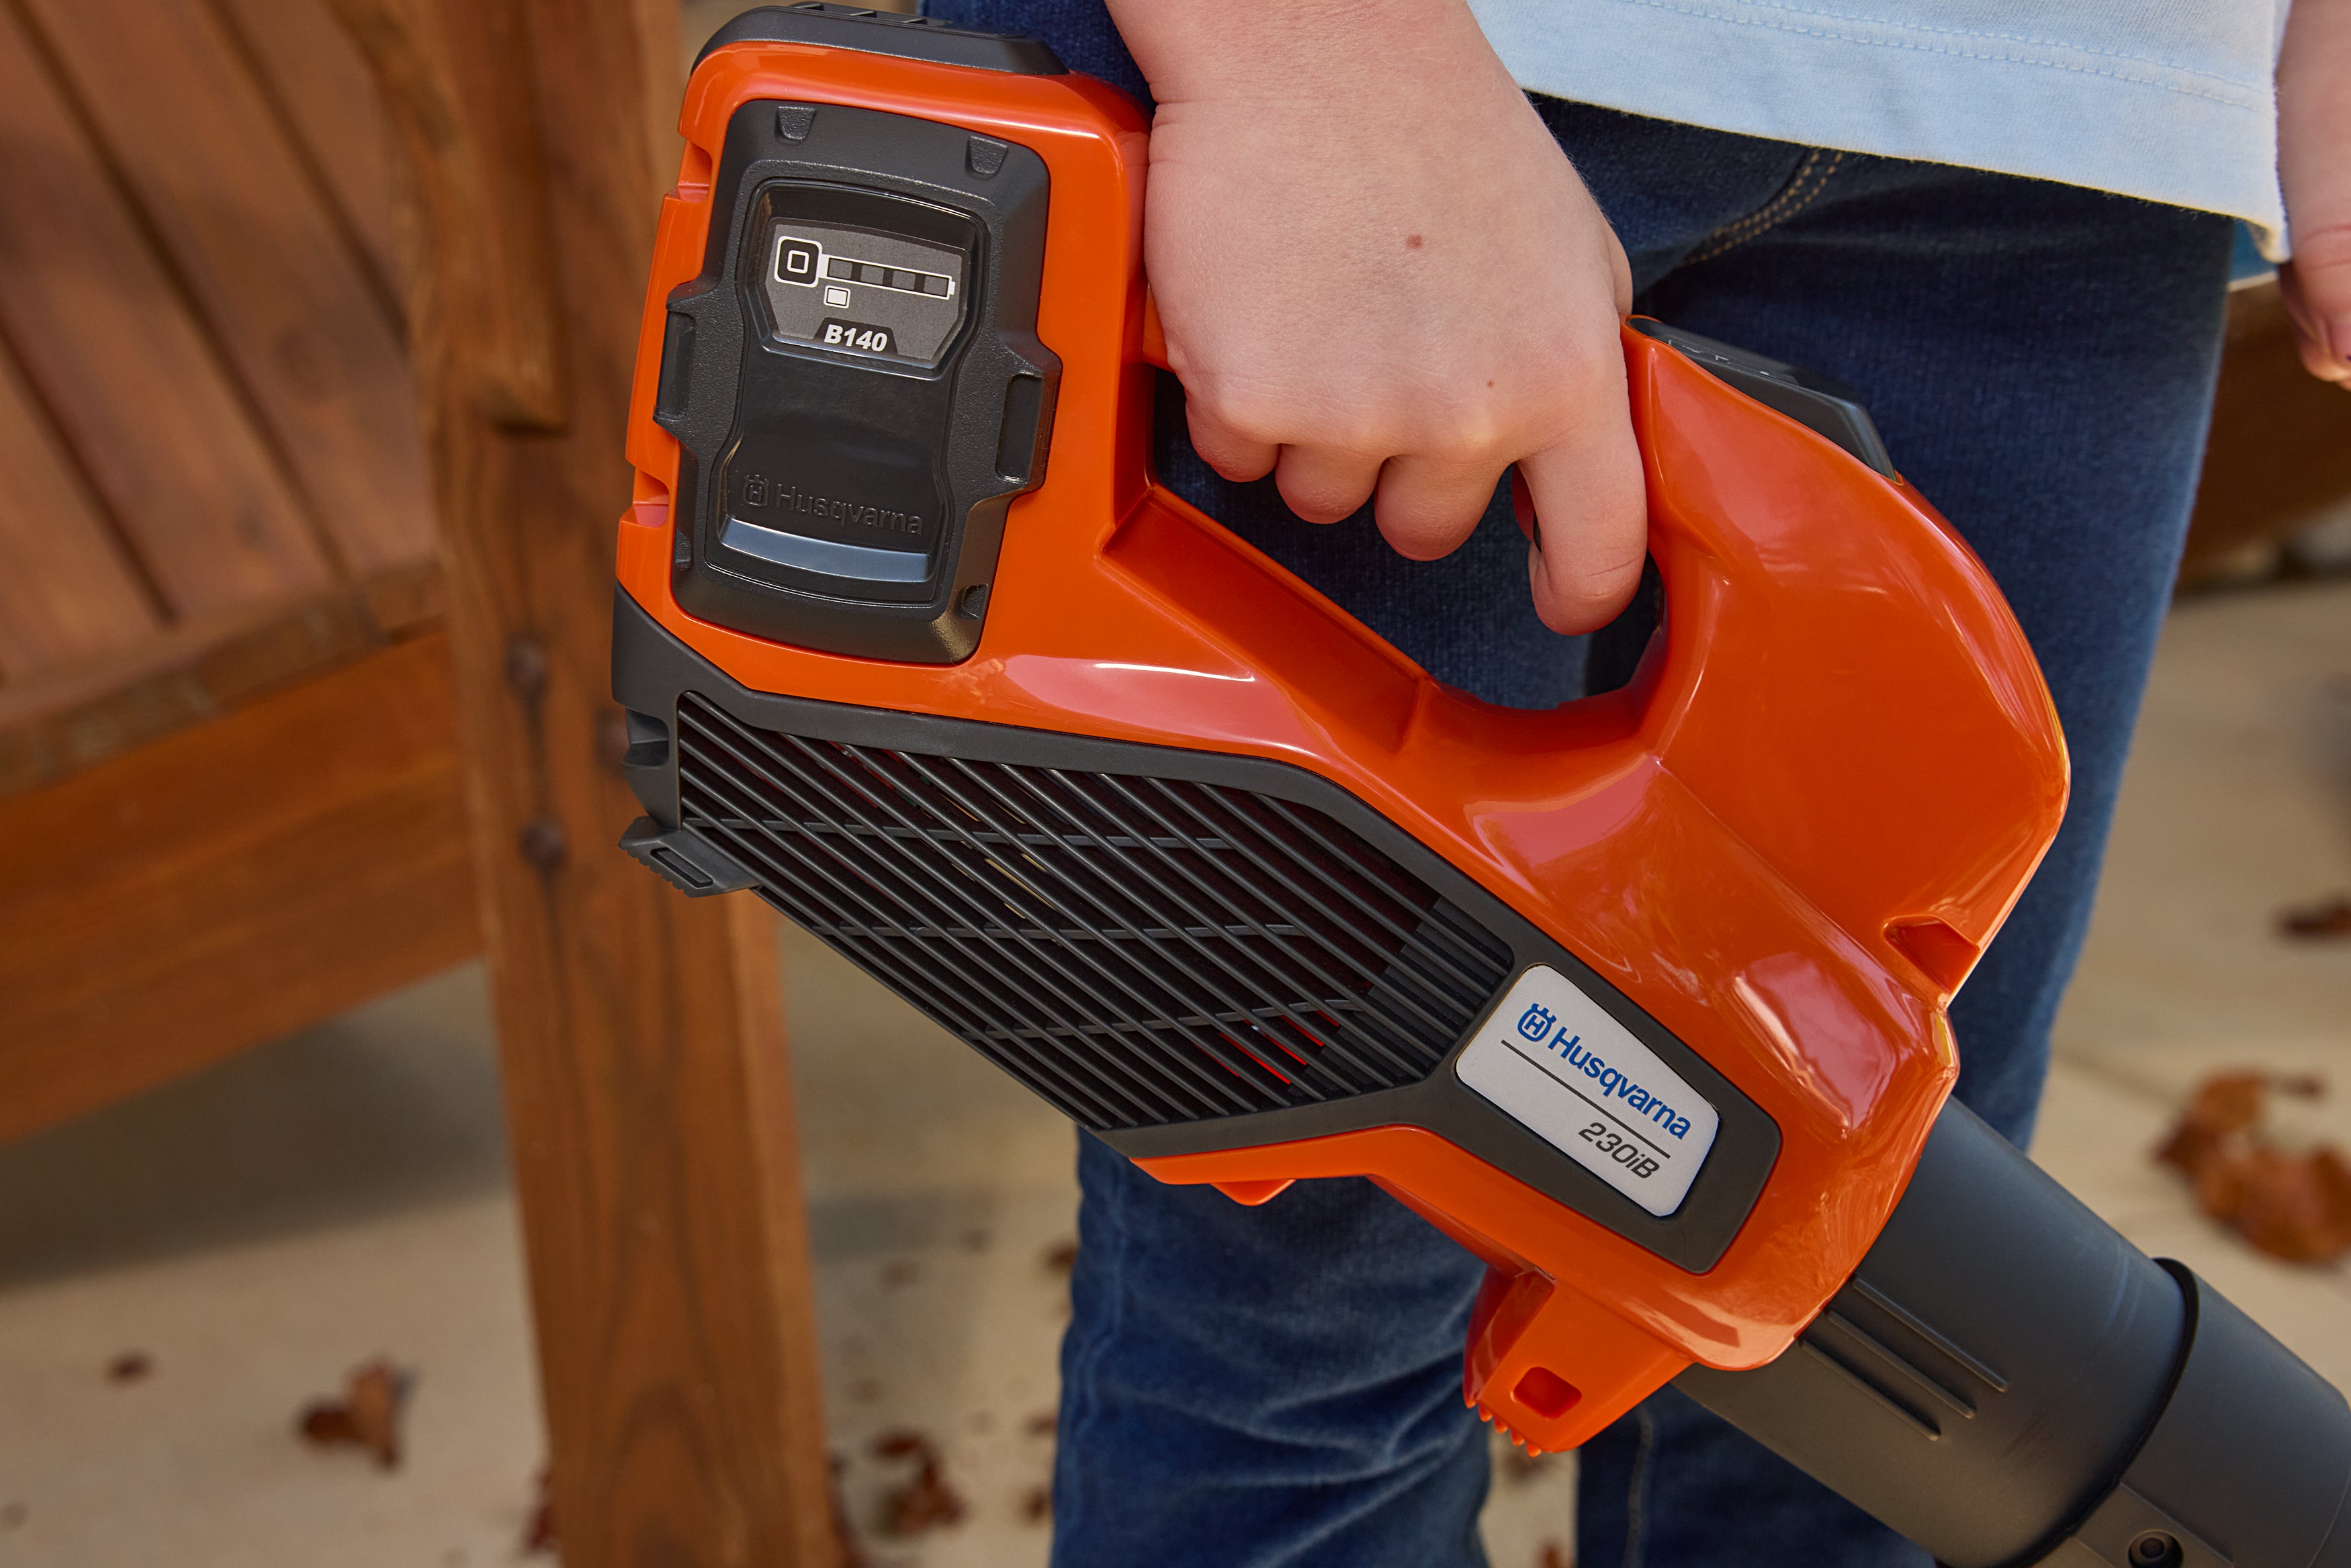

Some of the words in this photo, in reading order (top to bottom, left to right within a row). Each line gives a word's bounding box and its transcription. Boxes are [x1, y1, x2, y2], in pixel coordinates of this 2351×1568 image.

[824, 324, 888, 353] B140
[775, 483, 923, 536] Husqvarna
[1547, 1025, 1691, 1140] Husqvarna
[1577, 1121, 1660, 1179] 230iB
